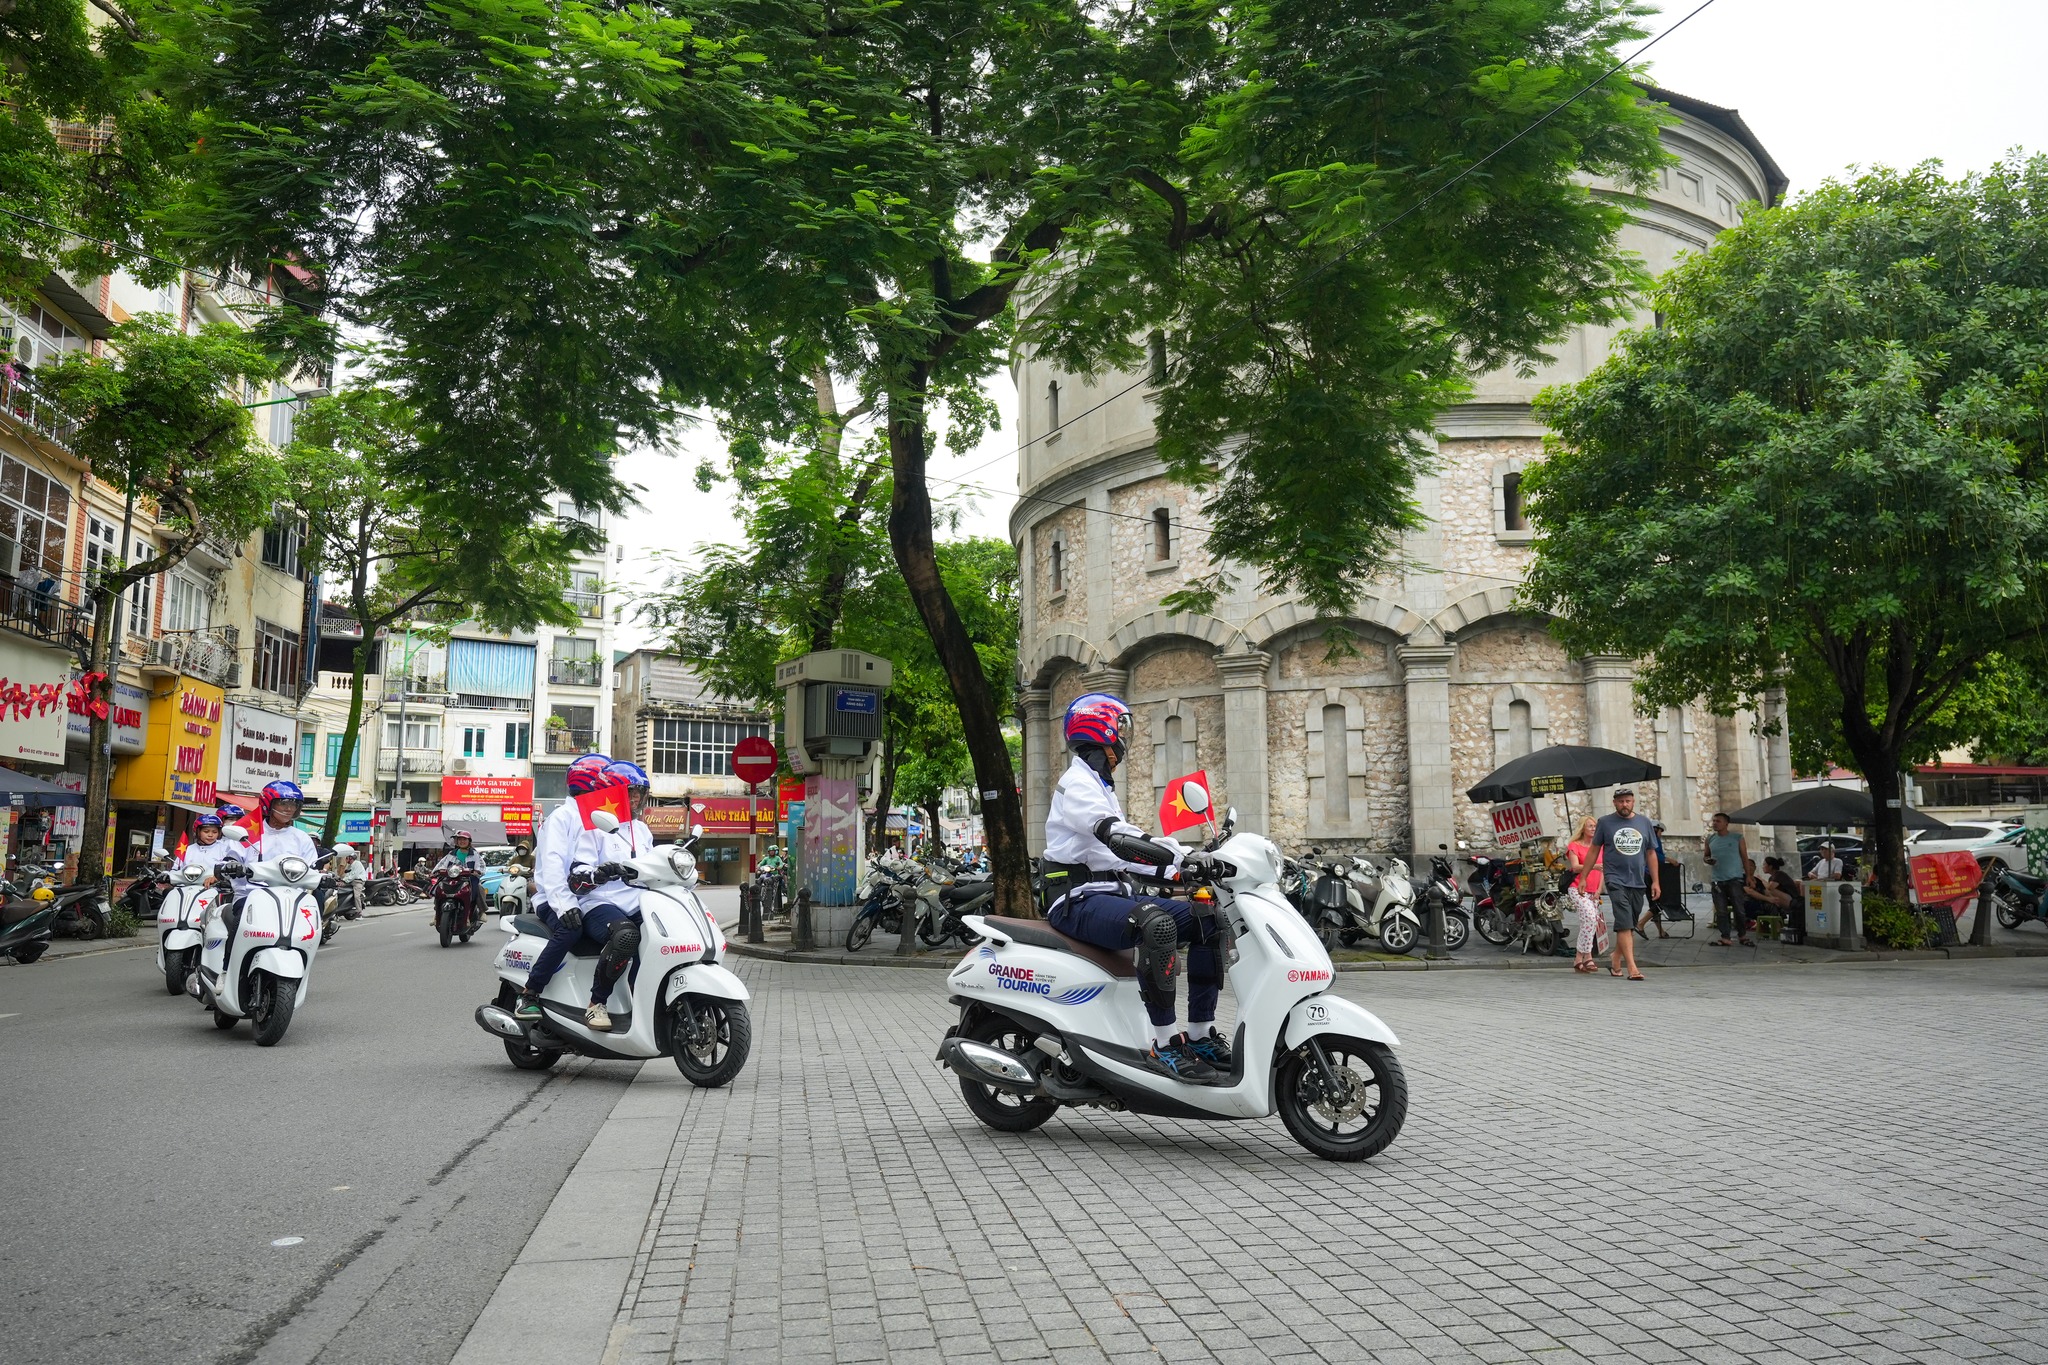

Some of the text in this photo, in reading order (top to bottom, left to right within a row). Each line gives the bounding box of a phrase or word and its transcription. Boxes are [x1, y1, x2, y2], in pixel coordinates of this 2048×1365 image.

[180, 688, 220, 723] BÁNH MÌ
[113, 706, 142, 729] LẠNH
[192, 778, 217, 805] HOA
[417, 815, 438, 824] NINH
[645, 815, 684, 824] Yên Ninh
[704, 807, 726, 821] VÀNG
[729, 807, 750, 822] THÁI
[1492, 801, 1538, 833] KHÓA
[1499, 826, 1541, 846] 09666 11044
[670, 944, 701, 954] YAMAHA
[506, 959, 530, 970] TOURING
[988, 963, 1034, 981] GRANDE
[674, 975, 684, 986] 70
[1300, 970, 1330, 981] YAMAHA
[997, 977, 1050, 995] TOURING
[1310, 1006, 1325, 1018] 70
